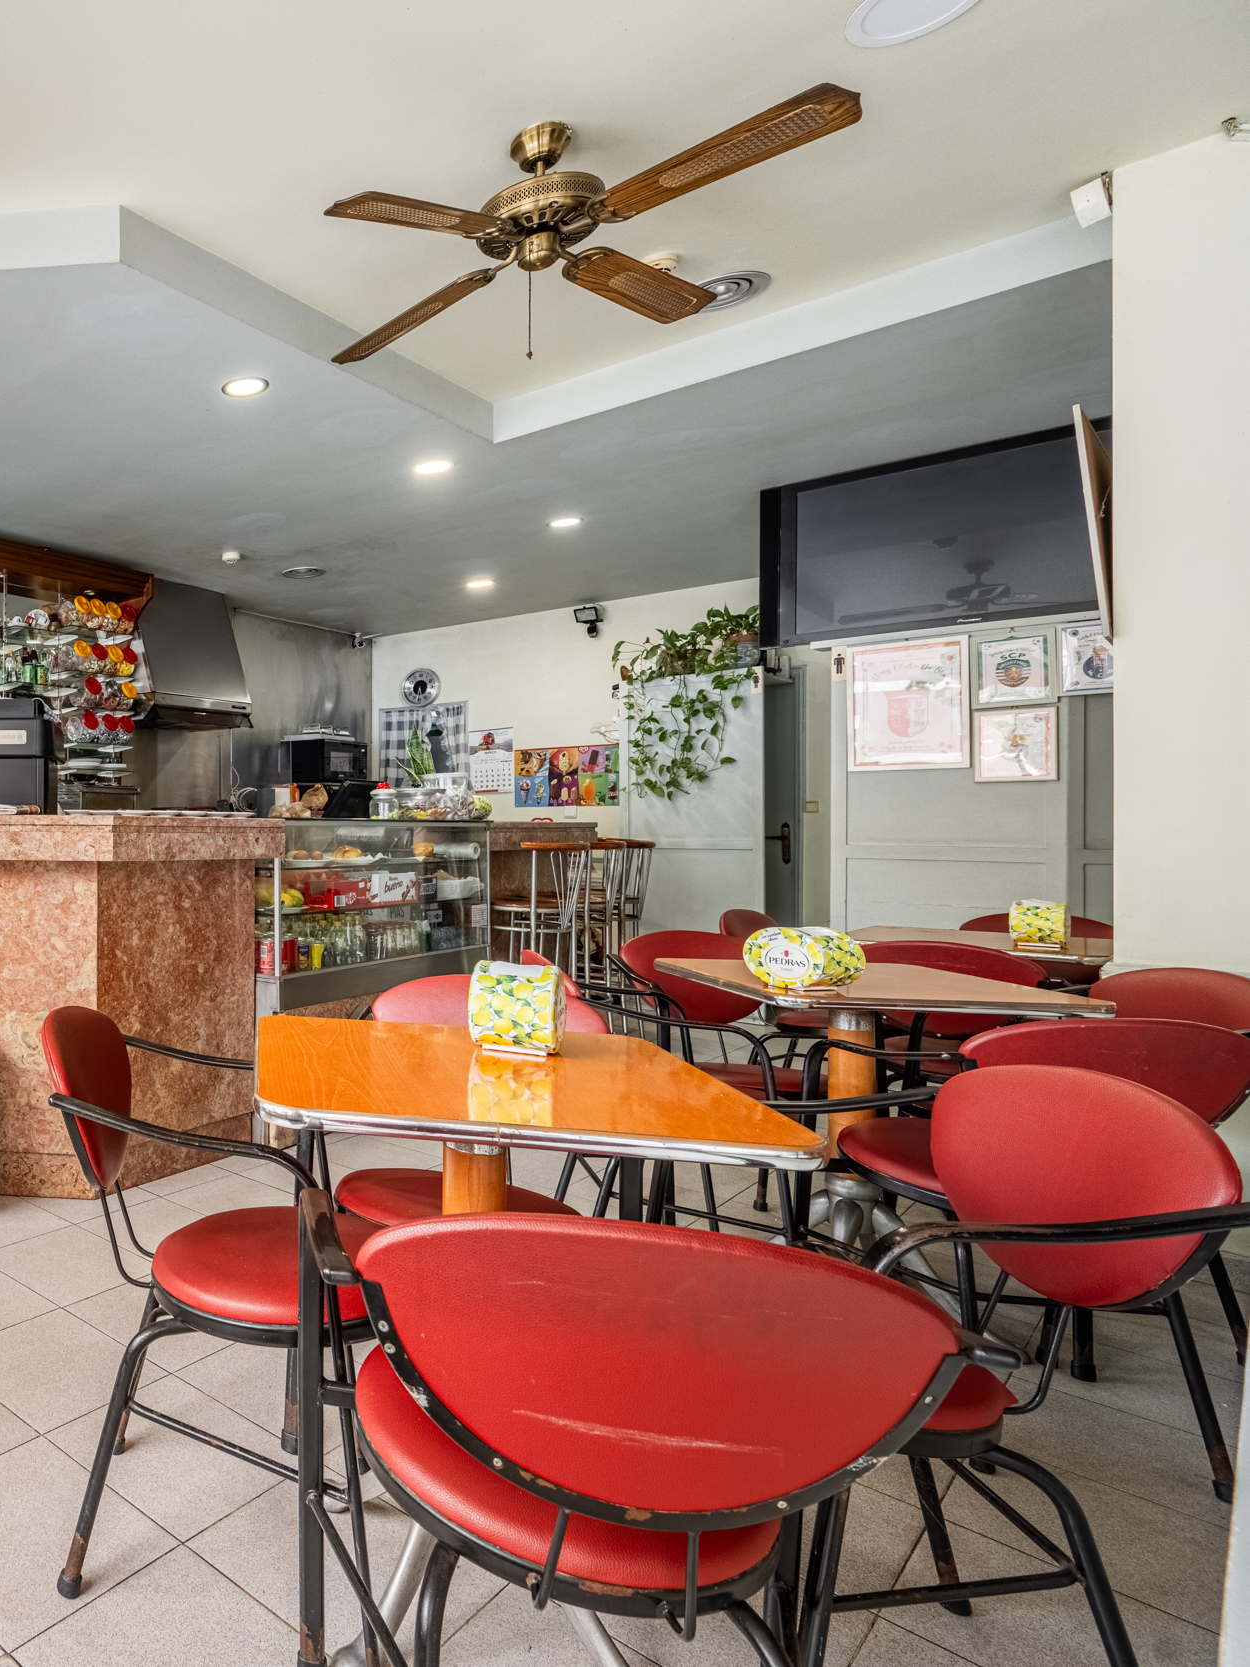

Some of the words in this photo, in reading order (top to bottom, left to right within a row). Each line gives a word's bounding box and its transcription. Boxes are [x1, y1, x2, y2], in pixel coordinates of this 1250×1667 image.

[1000, 652, 1026, 661] SCP
[384, 880, 404, 893] bueno
[769, 956, 806, 968] PEDRAS
